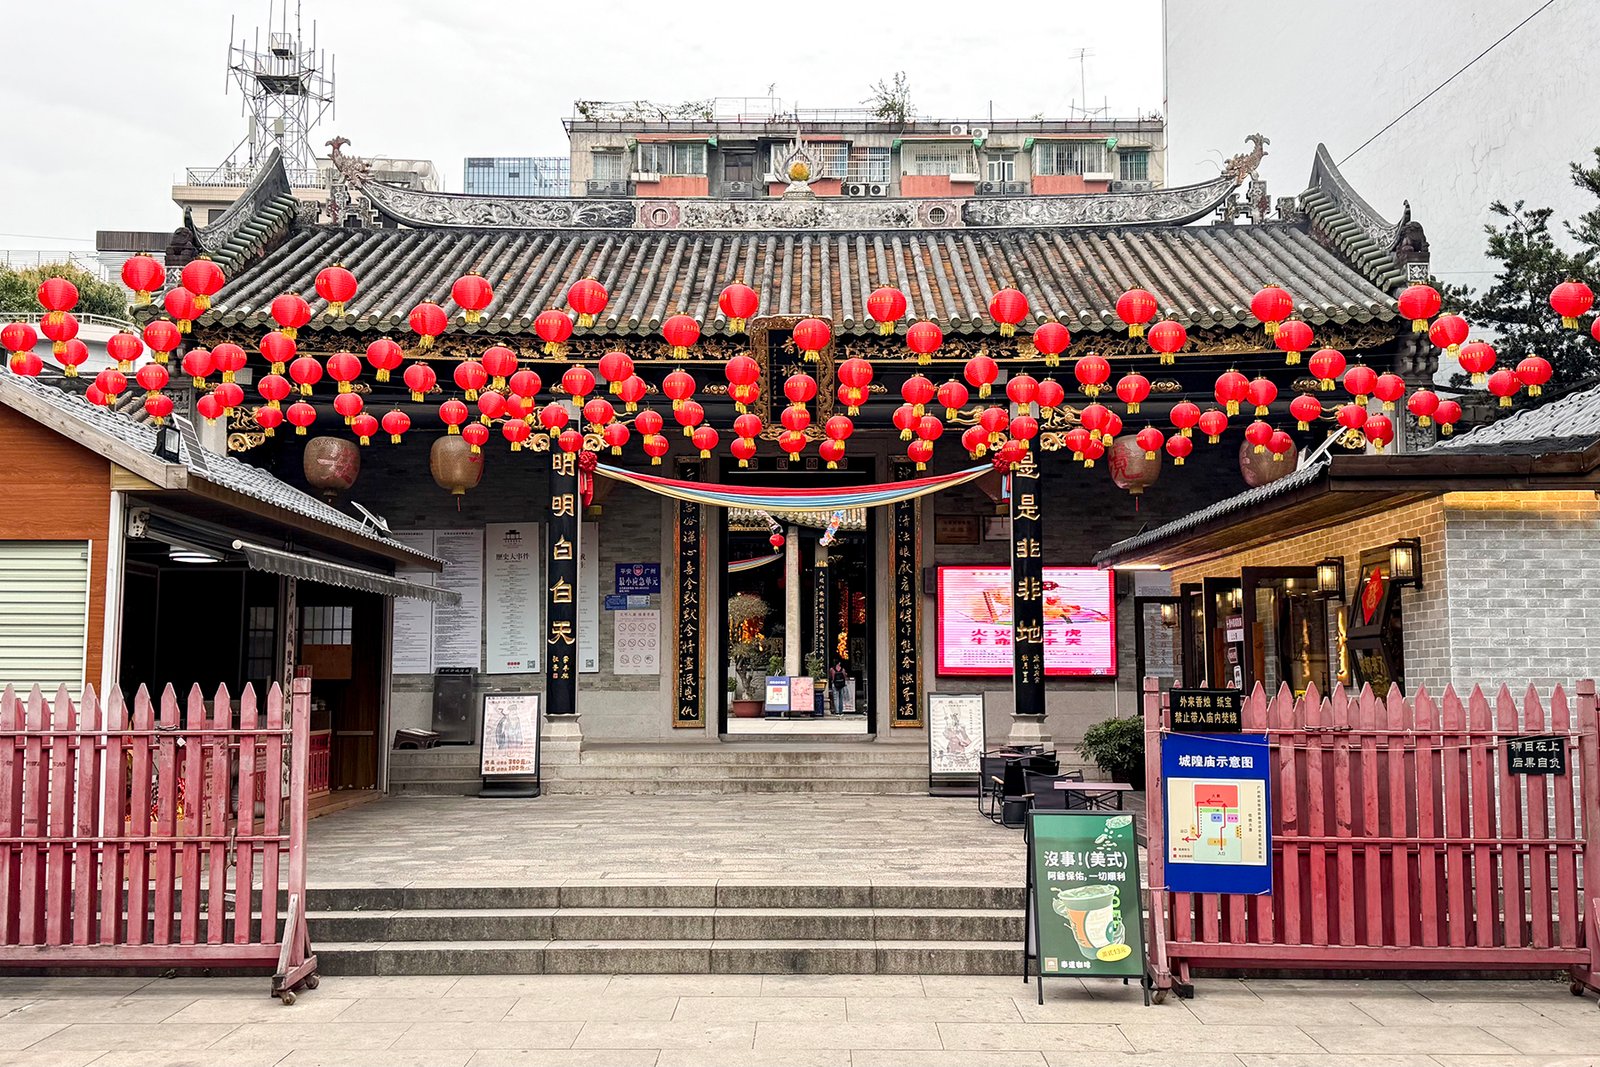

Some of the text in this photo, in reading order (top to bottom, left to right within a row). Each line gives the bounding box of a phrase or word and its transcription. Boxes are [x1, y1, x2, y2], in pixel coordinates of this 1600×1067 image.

[548, 453, 575, 644] 明明白白天
[619, 577, 658, 586] 最小应急单元
[971, 629, 1082, 637] 火灾于虎
[971, 637, 1082, 645] 生命于天
[1180, 696, 1232, 708] 外来香烛 纸宝
[1175, 711, 1238, 724] 禁止带入庙内焚烧
[1511, 741, 1560, 752] 神目在上
[1179, 755, 1254, 769] 城隍庙示意图
[1512, 757, 1561, 769] 后果自负
